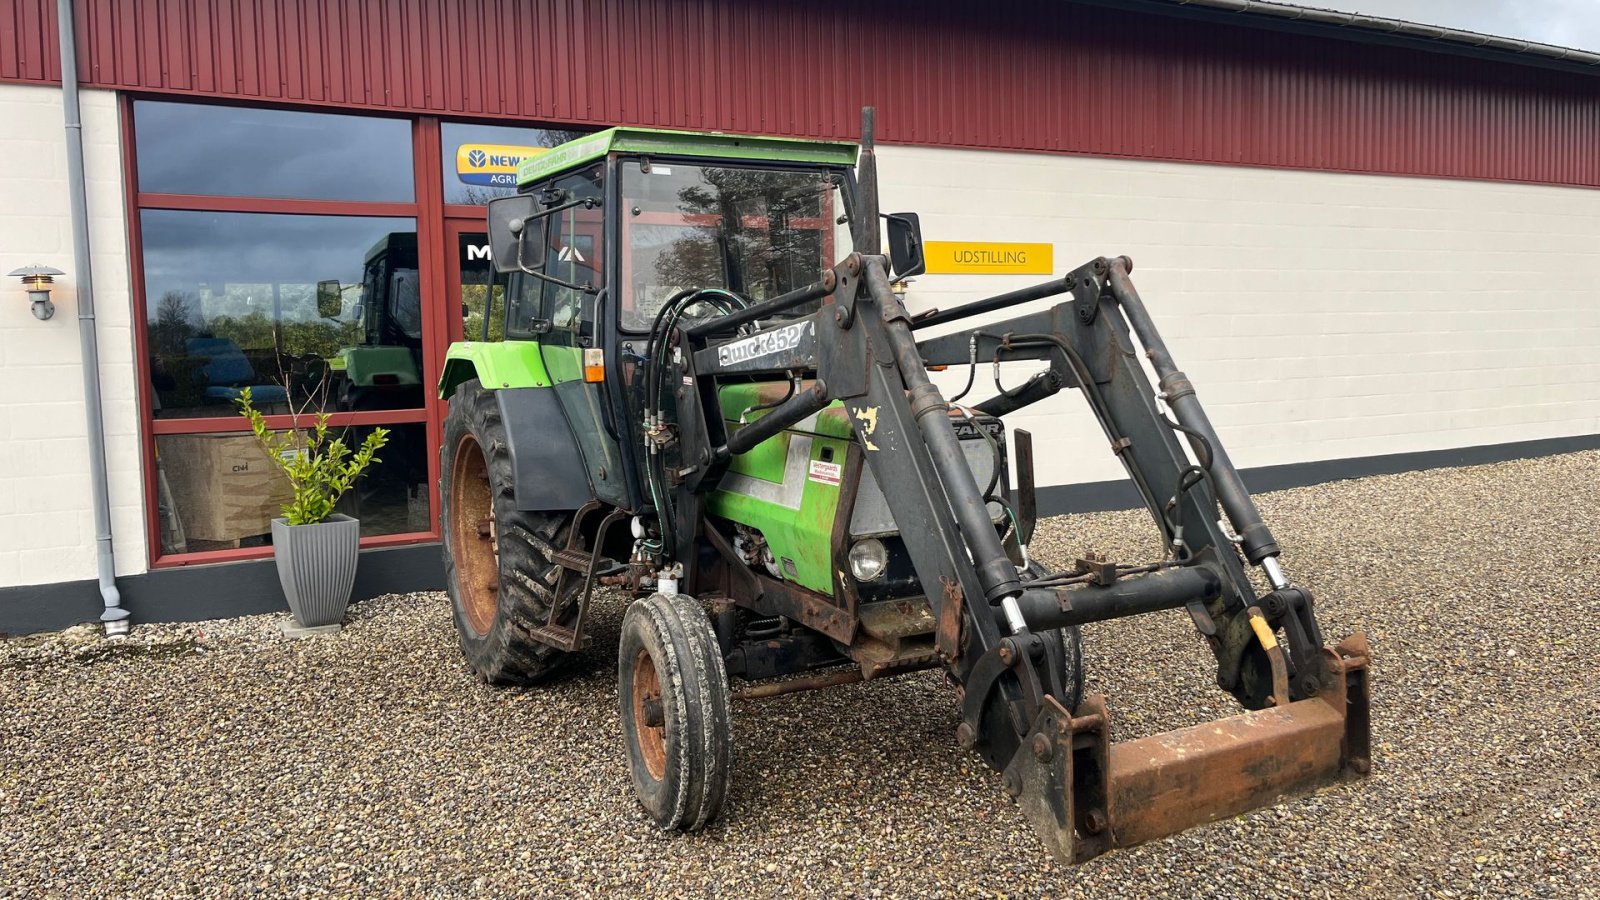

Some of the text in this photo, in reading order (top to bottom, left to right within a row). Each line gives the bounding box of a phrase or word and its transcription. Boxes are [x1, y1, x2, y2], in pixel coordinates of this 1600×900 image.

[490, 155, 520, 167] NEW
[490, 174, 517, 184] AGRI
[954, 251, 1026, 263] UDSTILLING
